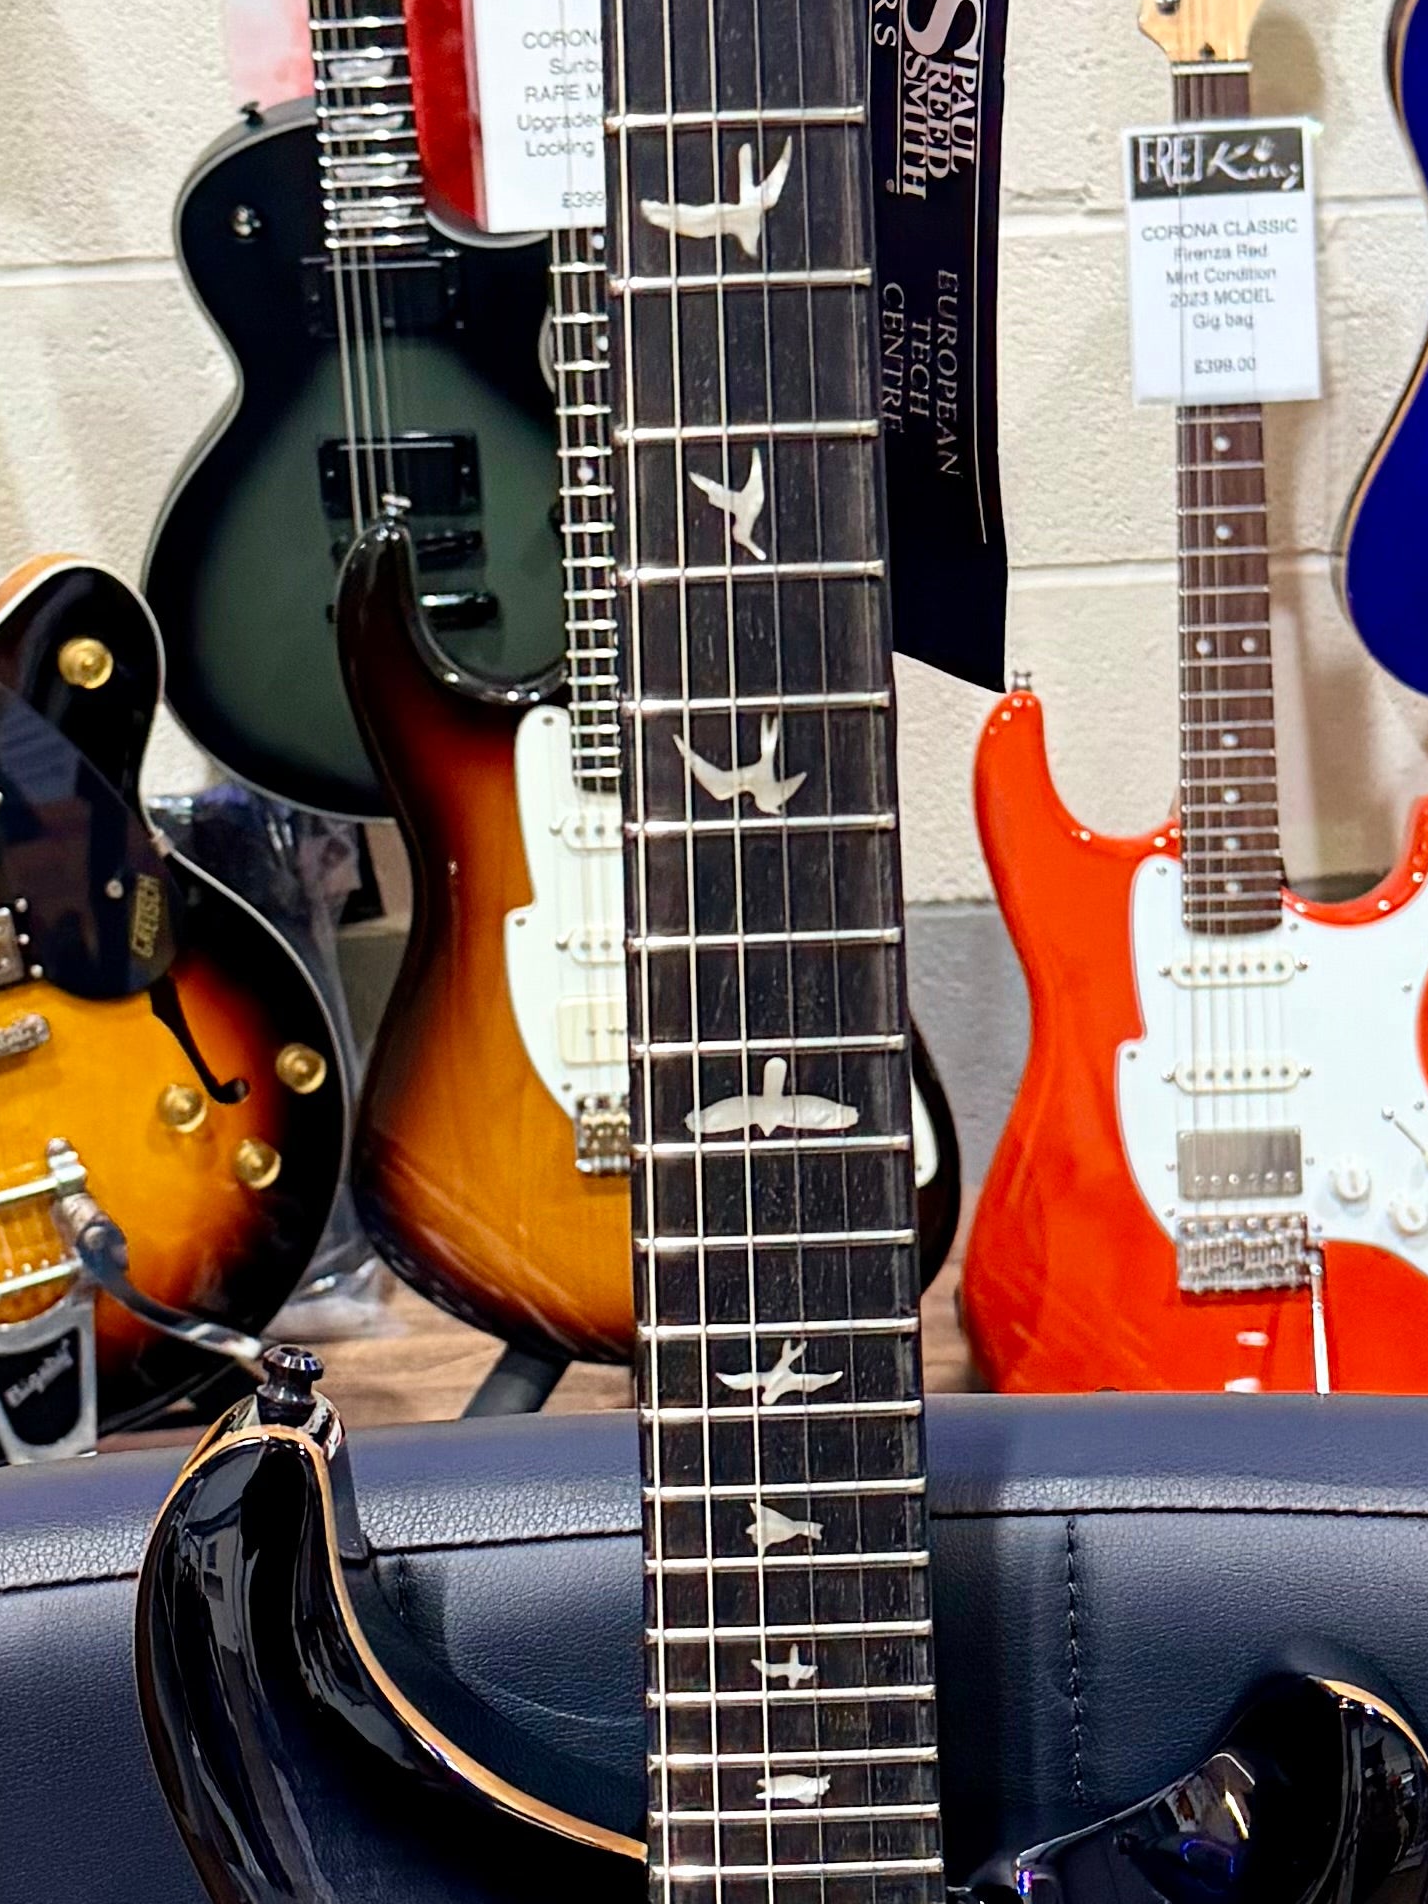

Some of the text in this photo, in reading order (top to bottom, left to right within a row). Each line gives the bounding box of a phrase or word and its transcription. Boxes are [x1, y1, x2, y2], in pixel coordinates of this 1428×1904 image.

[522, 28, 599, 50] CORON
[524, 82, 581, 104] RARE
[903, 51, 928, 201] SMITH
[926, 59, 952, 179] REED
[950, 60, 978, 174] PAUL
[525, 140, 595, 159] Locking
[1138, 133, 1205, 189] FRET
[1141, 218, 1299, 242] CORONA CLASSIC
[1173, 242, 1269, 263] Firenza Red
[1166, 265, 1277, 286] Mint Condition
[1213, 288, 1276, 306] MODEL
[1192, 310, 1255, 332] Gig bag
[881, 281, 905, 434] CENTRE
[909, 317, 932, 418] TECH
[936, 269, 962, 477] EUROPEAN
